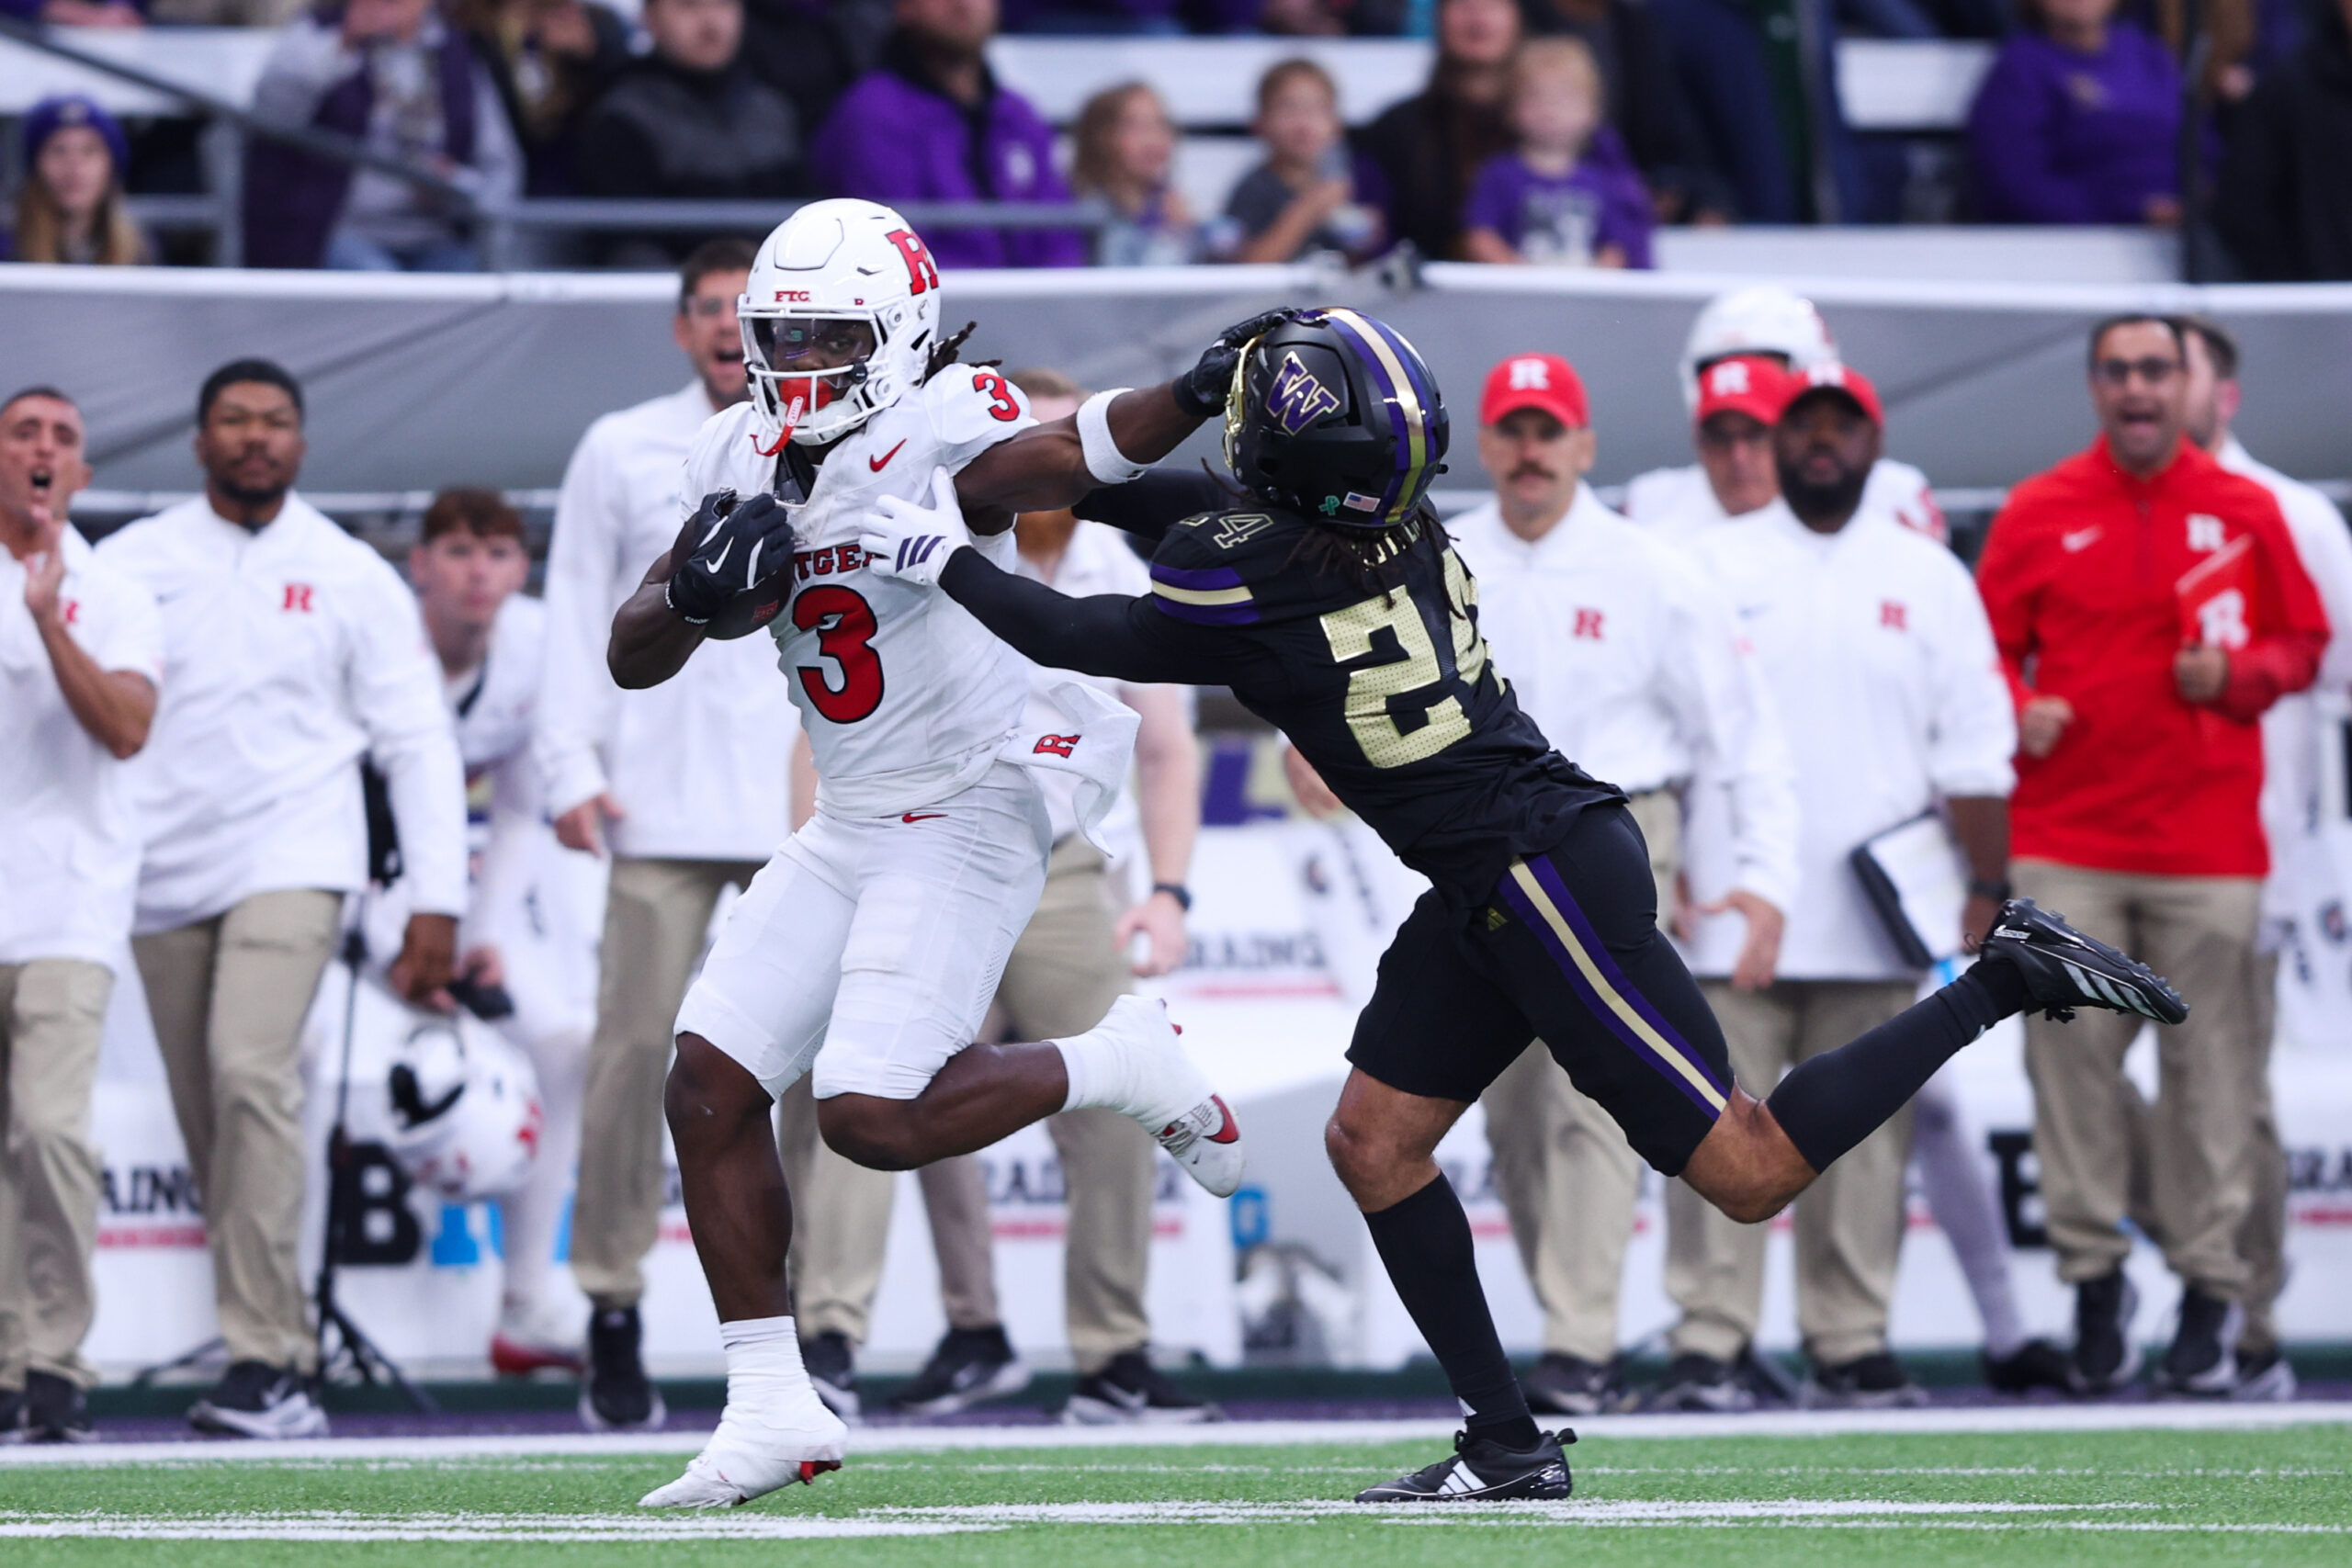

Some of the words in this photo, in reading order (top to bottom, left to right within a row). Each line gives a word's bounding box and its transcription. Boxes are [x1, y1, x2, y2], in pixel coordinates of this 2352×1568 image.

[884, 229, 939, 297] R
[1265, 351, 1340, 436] W
[1510, 357, 1549, 391] R
[972, 373, 1020, 422] 3
[284, 582, 313, 613] R
[1572, 607, 1607, 641] R
[792, 584, 885, 724] 3
[1033, 734, 1081, 759] R
